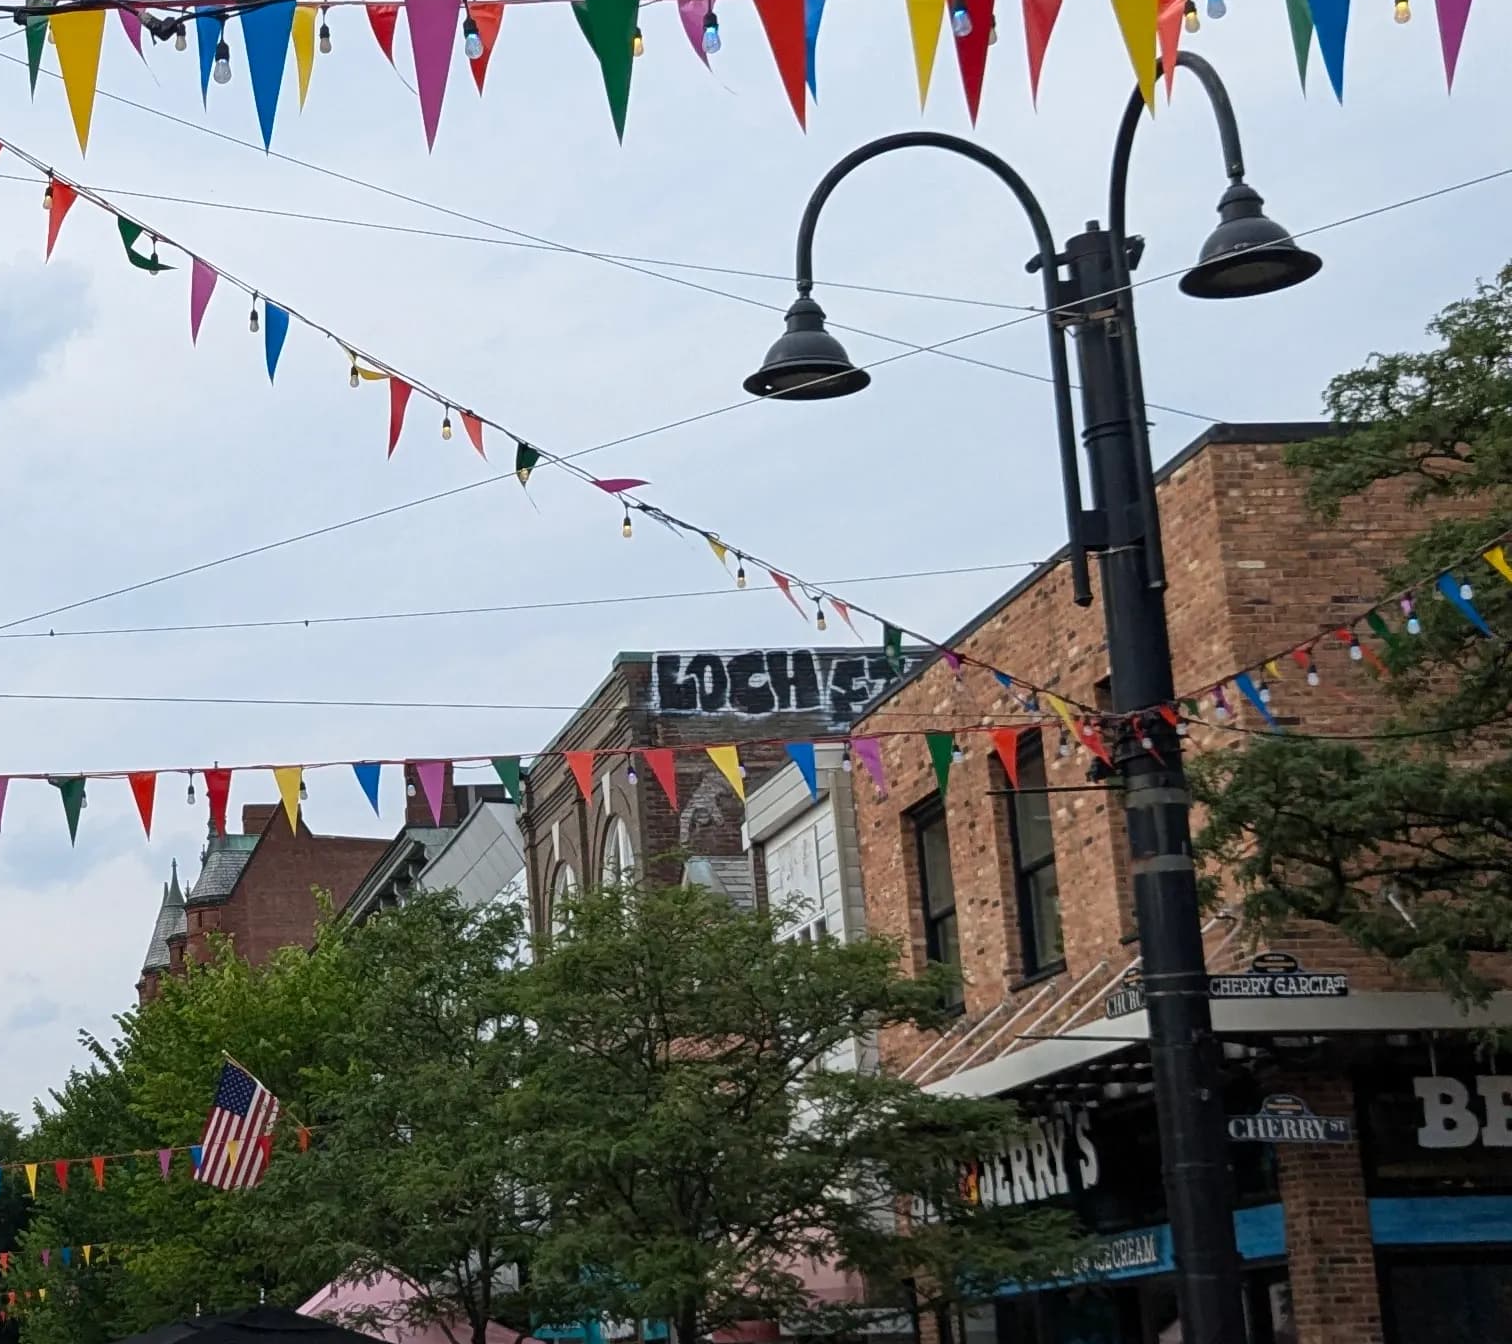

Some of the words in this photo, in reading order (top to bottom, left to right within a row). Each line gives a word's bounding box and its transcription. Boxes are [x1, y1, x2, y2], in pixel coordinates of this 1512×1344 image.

[1209, 976, 1273, 996] CHERRY
[1274, 976, 1338, 995] GARCIA
[1228, 1118, 1327, 1140] CHERRY
[1329, 1120, 1347, 1133] ST
[1111, 1232, 1157, 1269] CREAM
